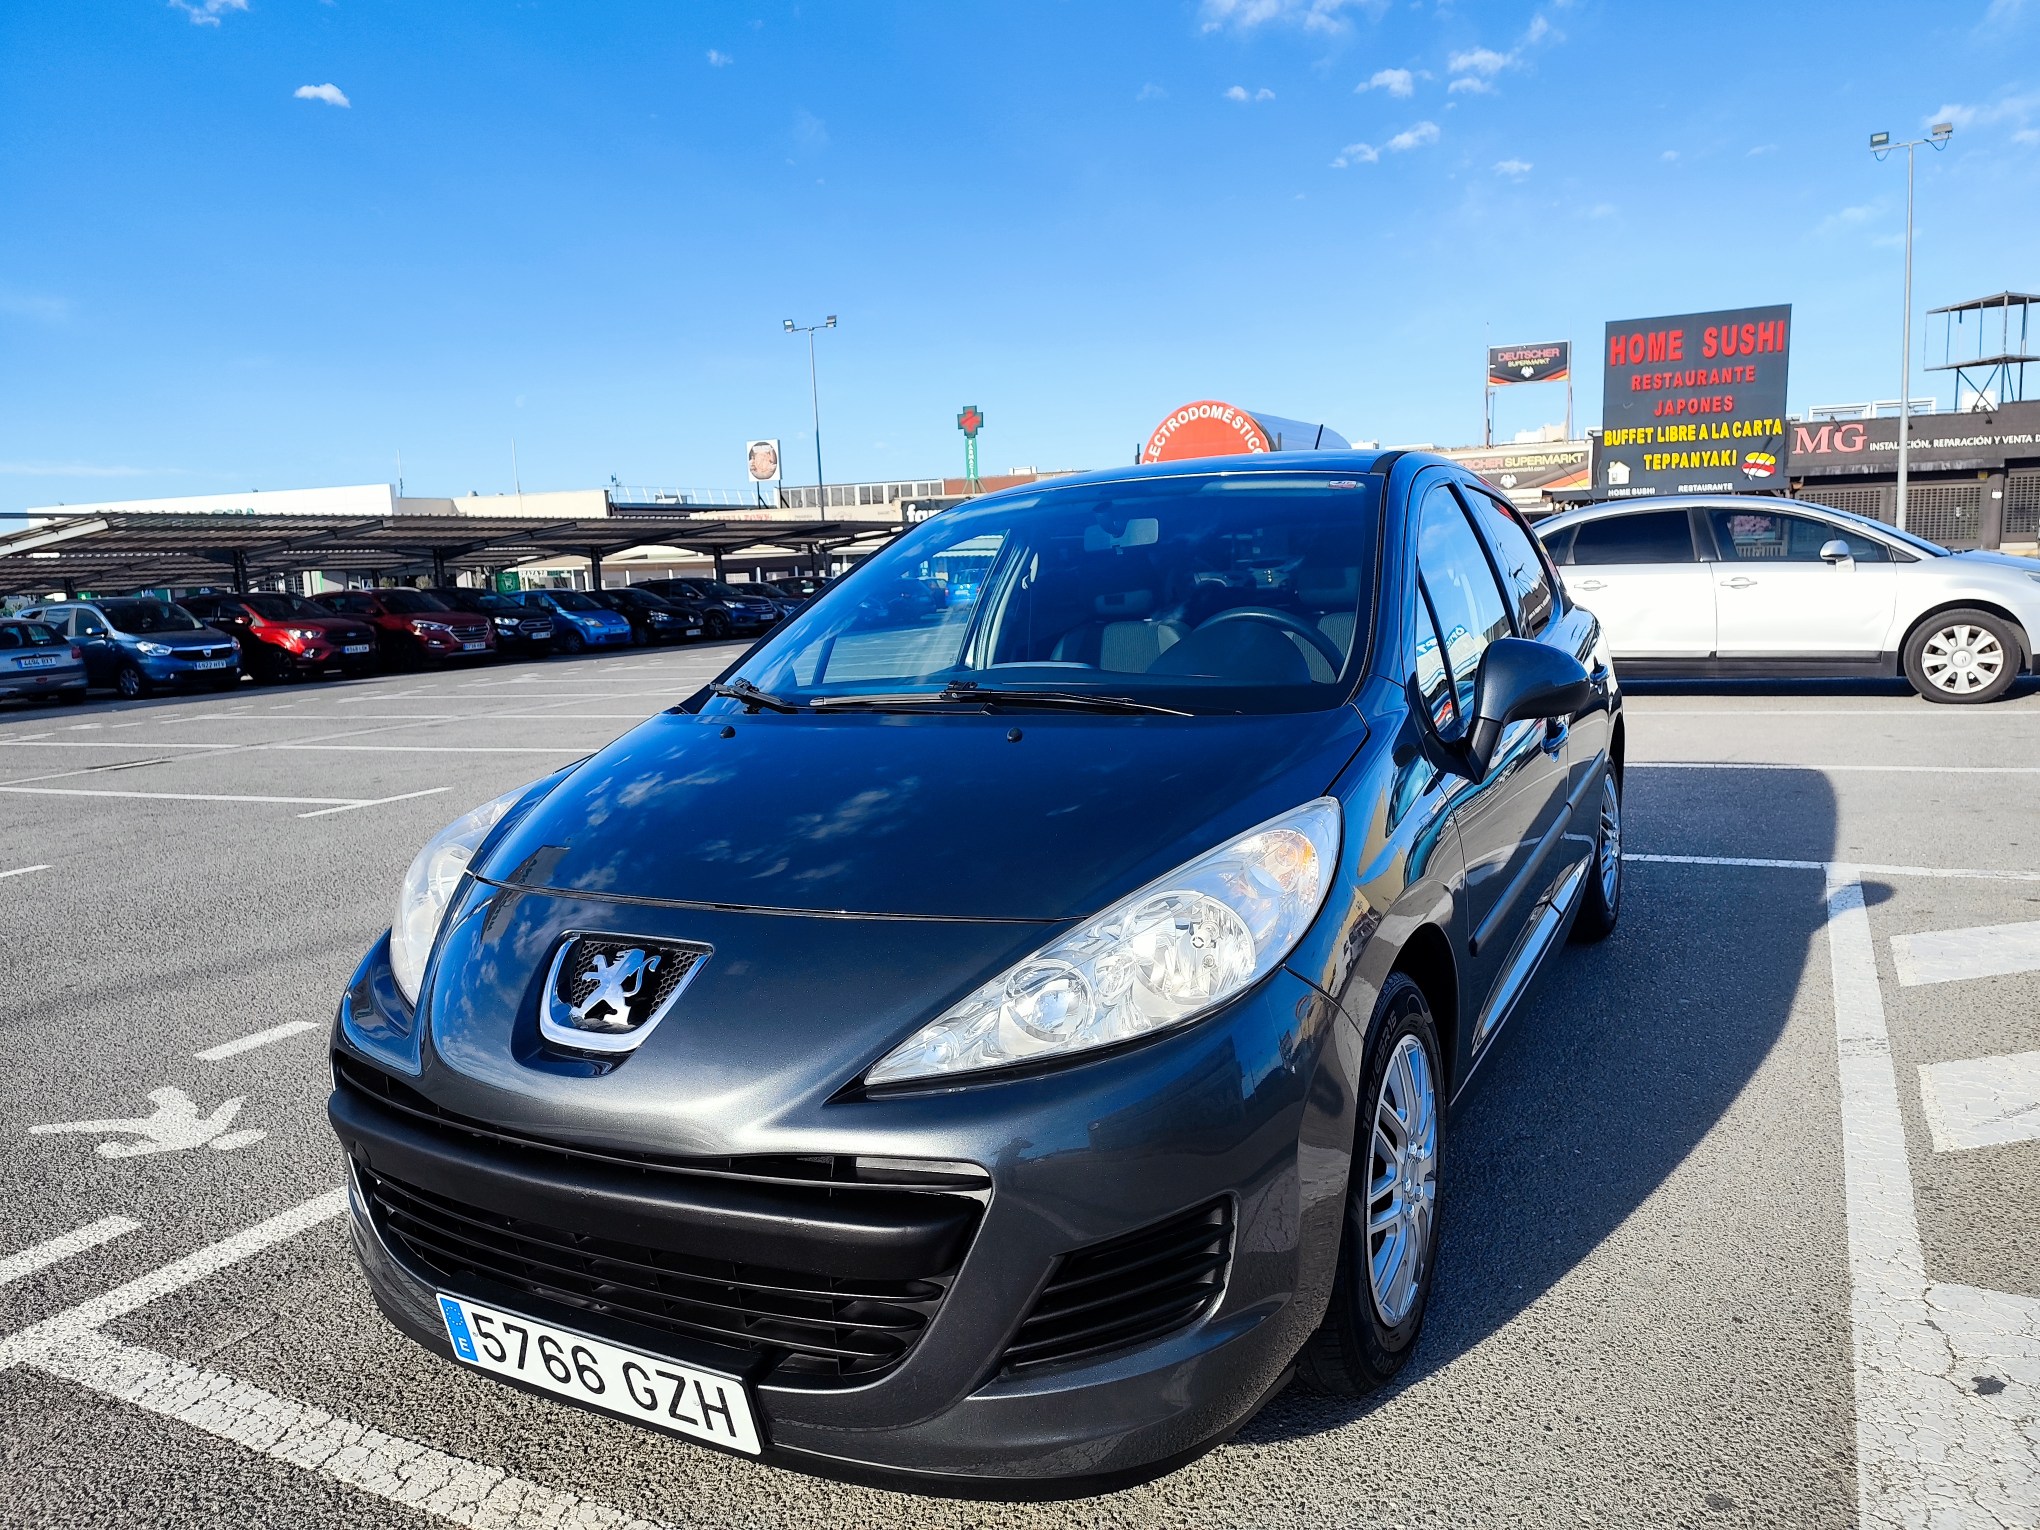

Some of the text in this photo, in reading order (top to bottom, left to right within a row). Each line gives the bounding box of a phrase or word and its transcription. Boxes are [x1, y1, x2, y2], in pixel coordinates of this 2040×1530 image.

[1609, 320, 1785, 366] HOME SUSHI
[1498, 347, 1560, 362] DEUTSCHER
[1507, 357, 1550, 368] SUPERMARKT
[1631, 365, 1756, 392] RESTAURANTE
[1653, 395, 1735, 417] JAPONES
[1144, 404, 1264, 464] LECTRODOMÉSTIC
[1603, 418, 1783, 446] BUFFET LIBRE A LA CARTA
[1792, 423, 1868, 455] MG
[1869, 437, 1932, 451] INSTALCIÓN,
[1933, 435, 1992, 448] REPARACIÓN
[1994, 435, 2001, 445] Y
[2002, 434, 2033, 444] VENTA
[1504, 453, 1584, 467] SUPERMARKT
[1643, 449, 1738, 471] TEPPANYAKI
[1607, 487, 1656, 497] HOME SUSHI
[1677, 482, 1733, 493] RESTAURANTE
[458, 1337, 471, 1353] E
[471, 1312, 737, 1438] 5766 GZH
